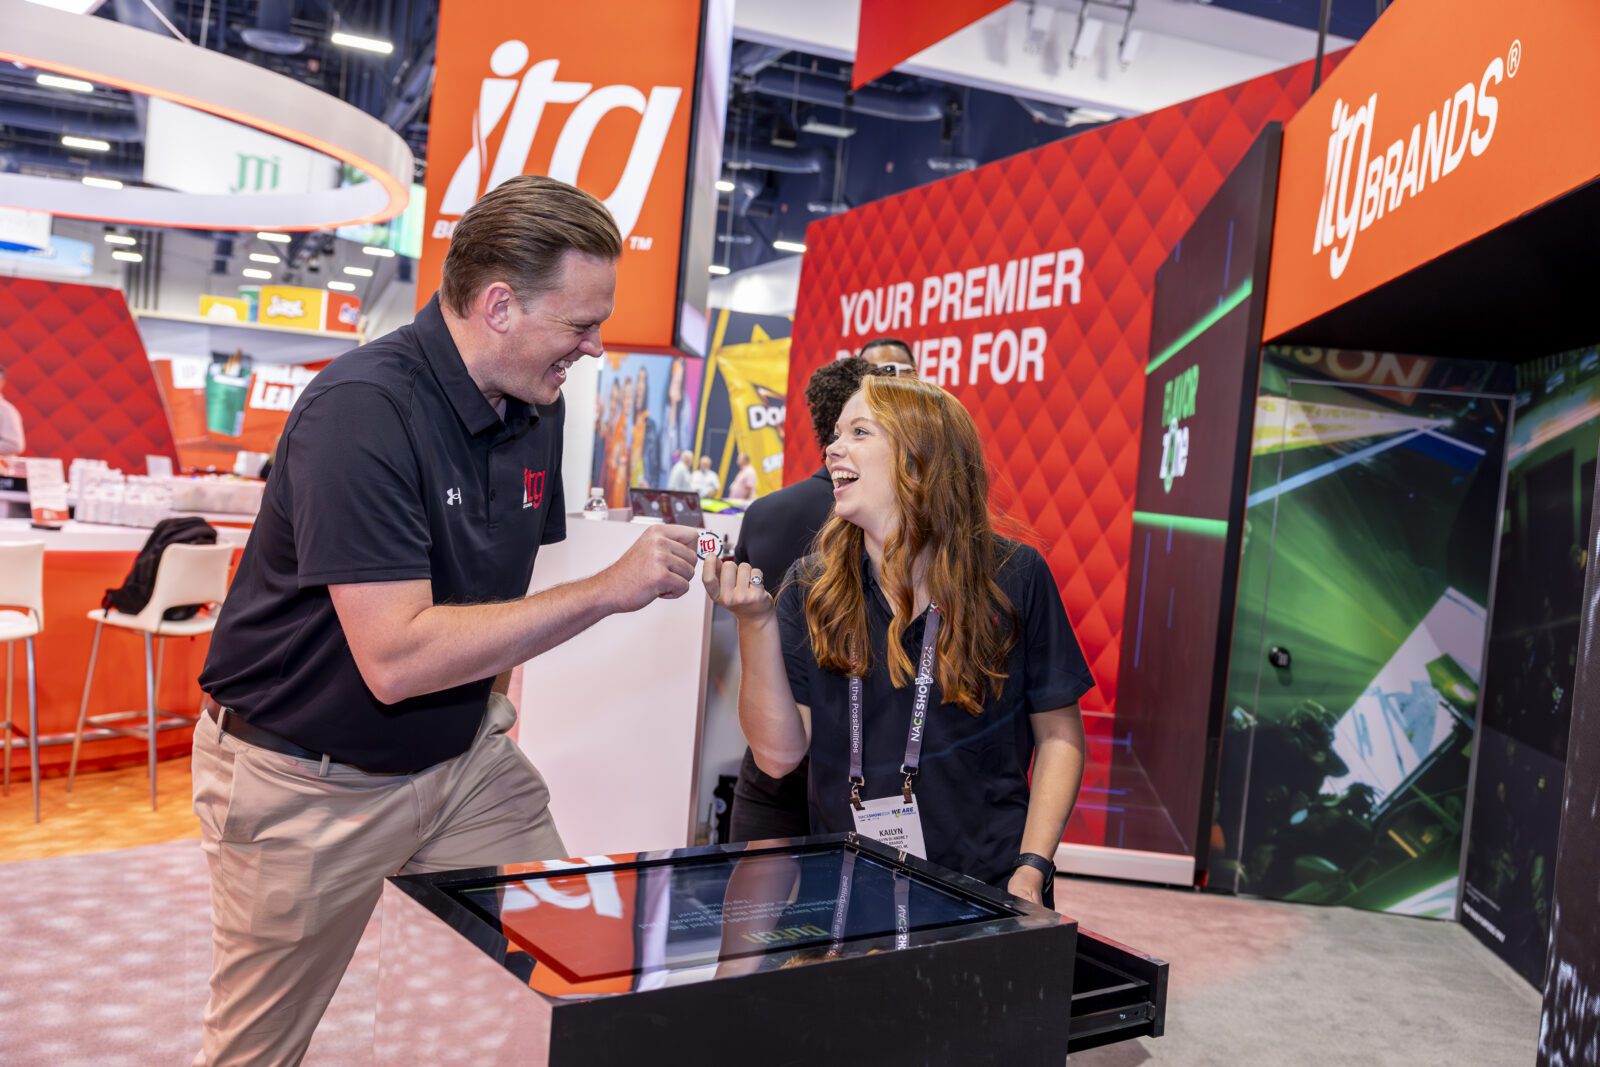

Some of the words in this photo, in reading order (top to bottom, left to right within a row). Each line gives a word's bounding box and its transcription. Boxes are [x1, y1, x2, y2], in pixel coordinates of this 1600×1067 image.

[1359, 57, 1504, 231] BRANDS
[840, 281, 915, 338] YOUR
[919, 247, 1085, 327] PREMIER
[968, 326, 1047, 385] FOR
[852, 686, 860, 700] the
[852, 704, 861, 754] Possibilities
[879, 827, 903, 837] KAILYN
